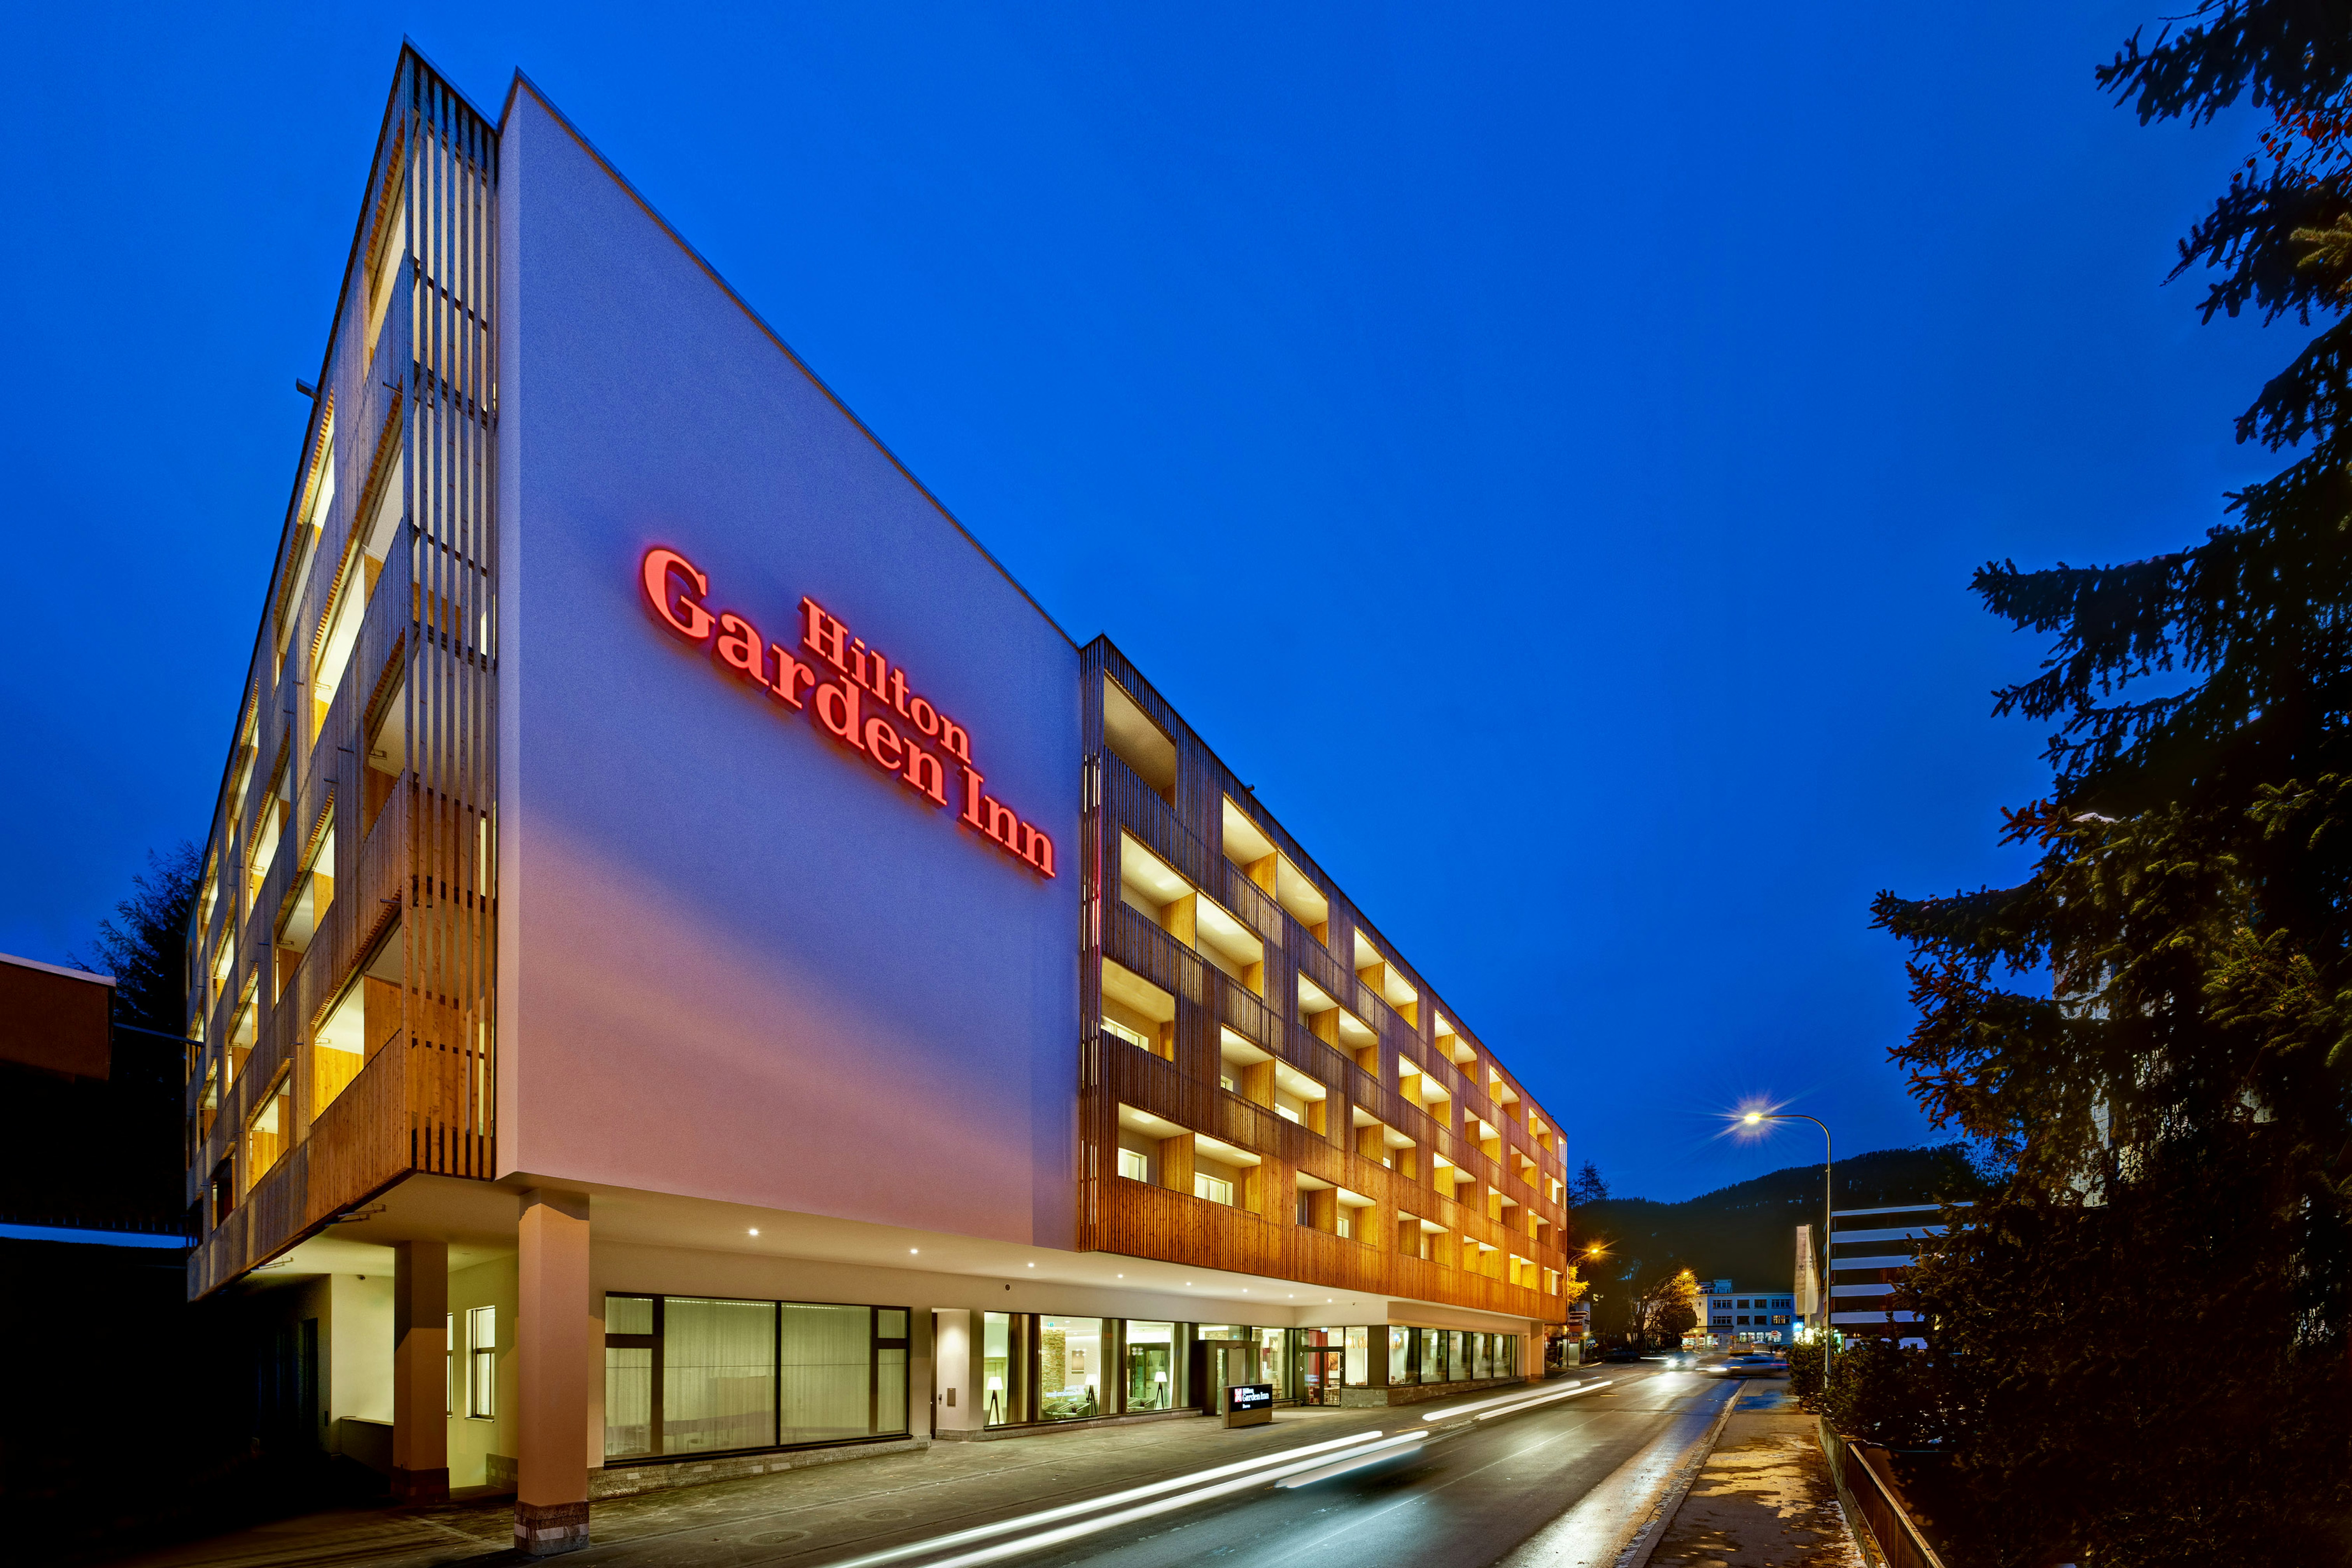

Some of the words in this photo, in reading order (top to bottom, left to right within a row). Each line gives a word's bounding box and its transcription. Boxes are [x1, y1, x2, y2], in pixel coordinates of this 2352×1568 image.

[644, 549, 947, 806] Garden
[962, 765, 1055, 878] Inn
[802, 596, 972, 765] Hilton
[1242, 1393, 1260, 1402] Garden
